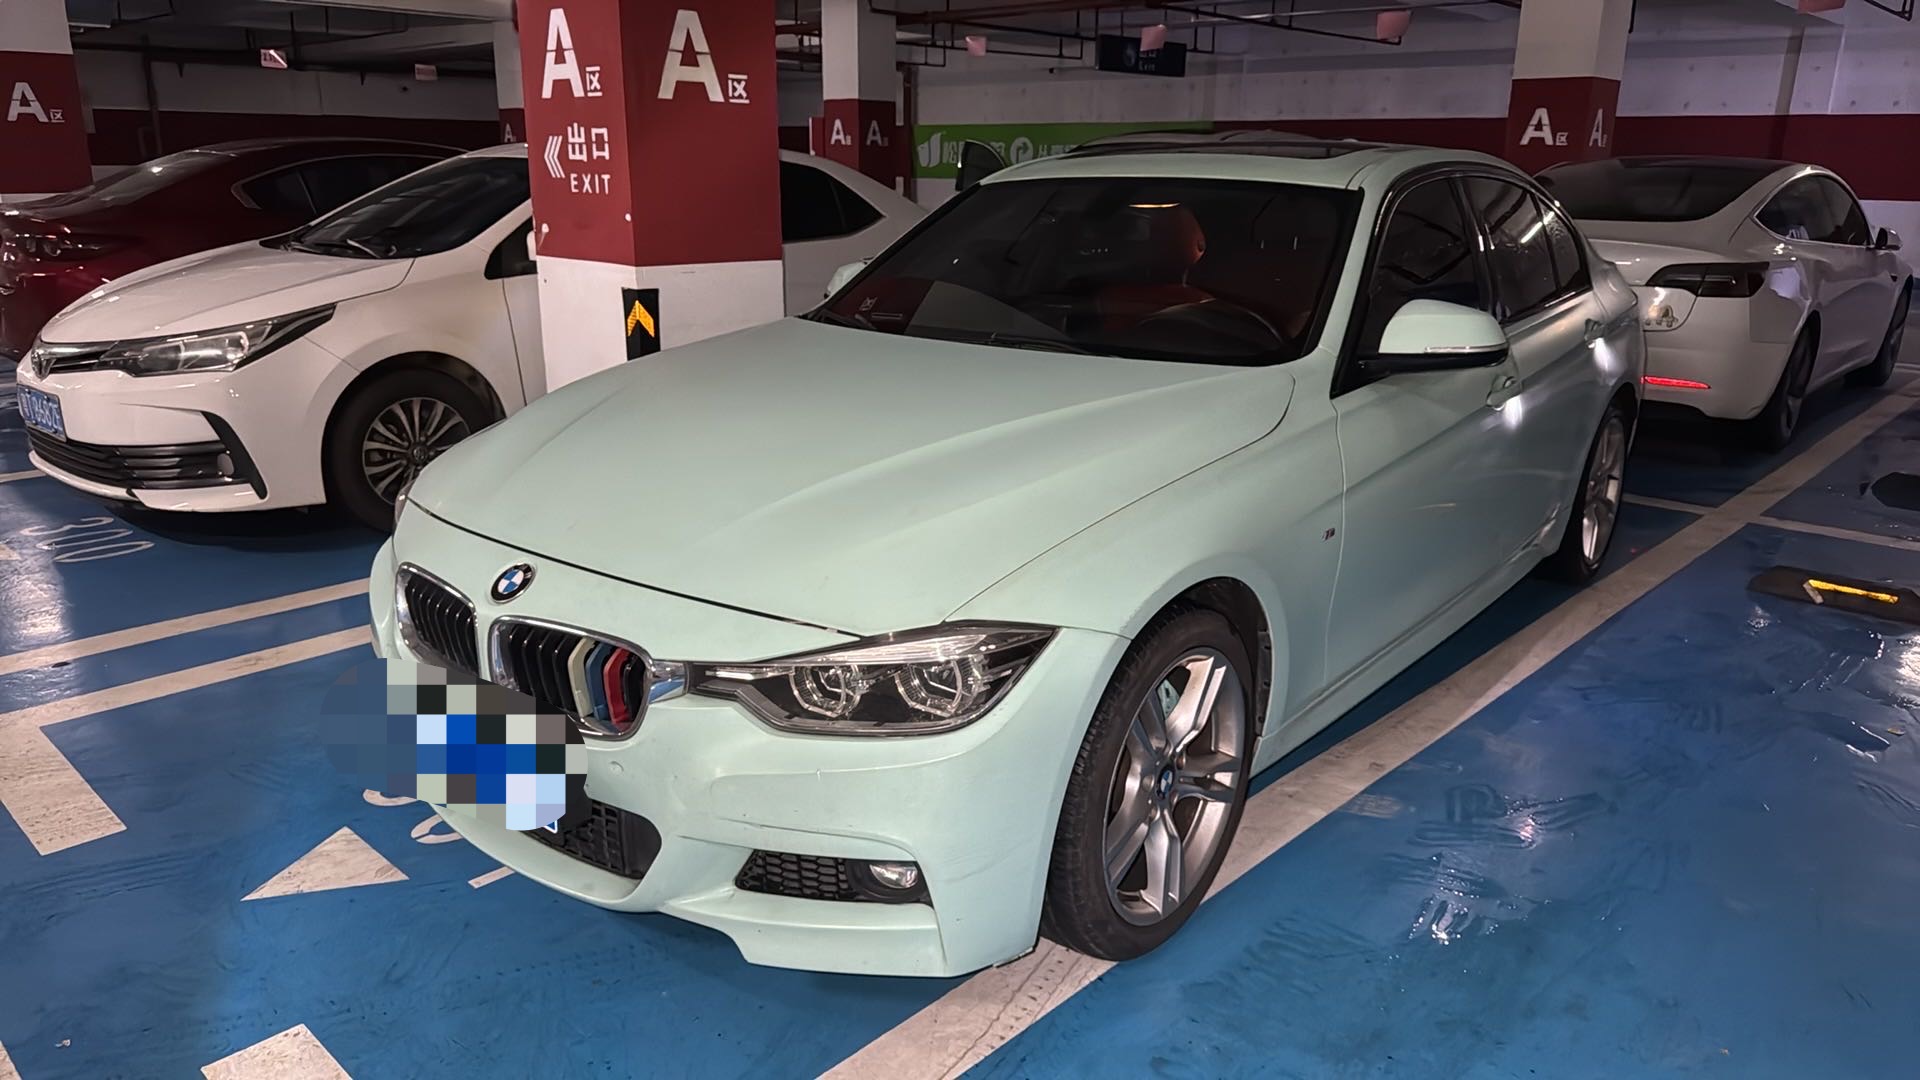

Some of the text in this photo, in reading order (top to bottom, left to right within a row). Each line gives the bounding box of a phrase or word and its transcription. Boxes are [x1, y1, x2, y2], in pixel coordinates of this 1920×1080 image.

[541, 8, 603, 99] A区
[657, 9, 750, 104] A区
[7, 82, 65, 123] A区
[567, 122, 610, 162] 出口
[1520, 108, 1568, 146] A区
[570, 173, 611, 194] EXIT
